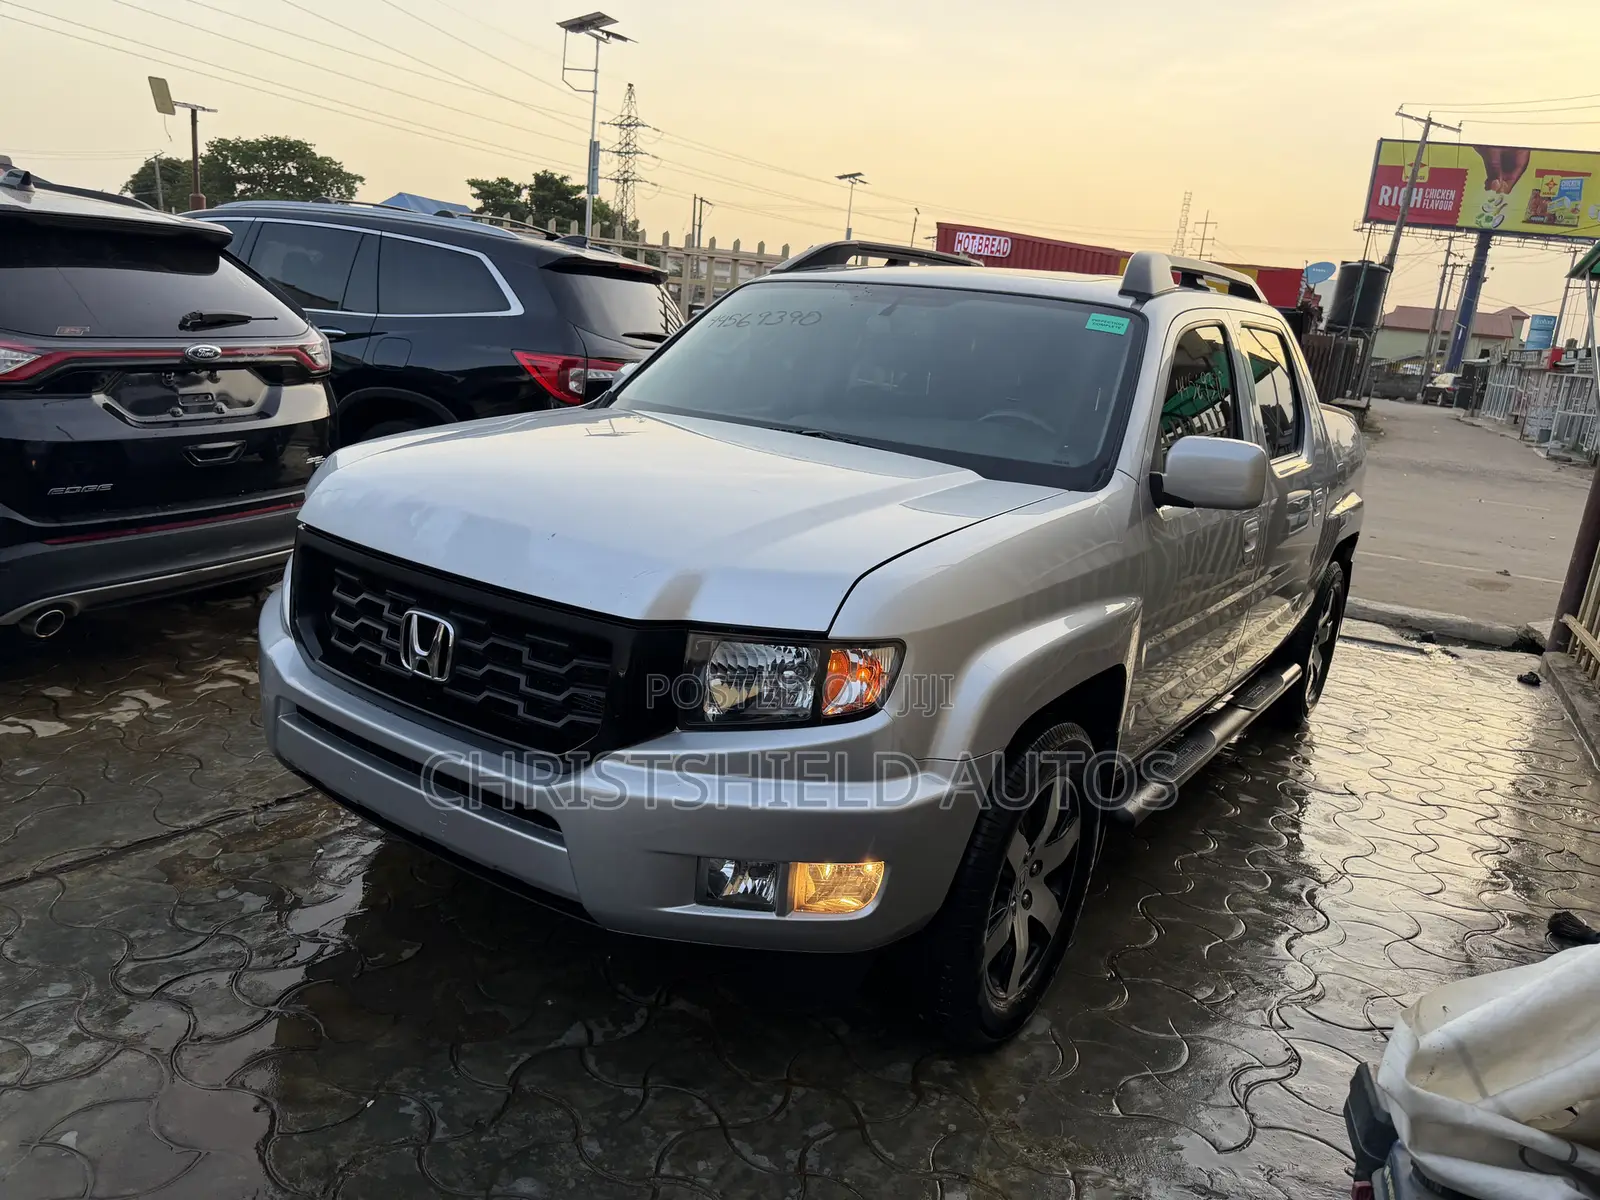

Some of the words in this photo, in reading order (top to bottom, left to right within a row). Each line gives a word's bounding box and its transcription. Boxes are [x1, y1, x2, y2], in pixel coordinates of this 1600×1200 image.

[1378, 185, 1424, 208] RICH
[1425, 188, 1456, 200] CHICKEN
[1422, 199, 1453, 211] FLAVOUR
[977, 235, 1010, 257] BREAD
[47, 483, 114, 496] EDGE
